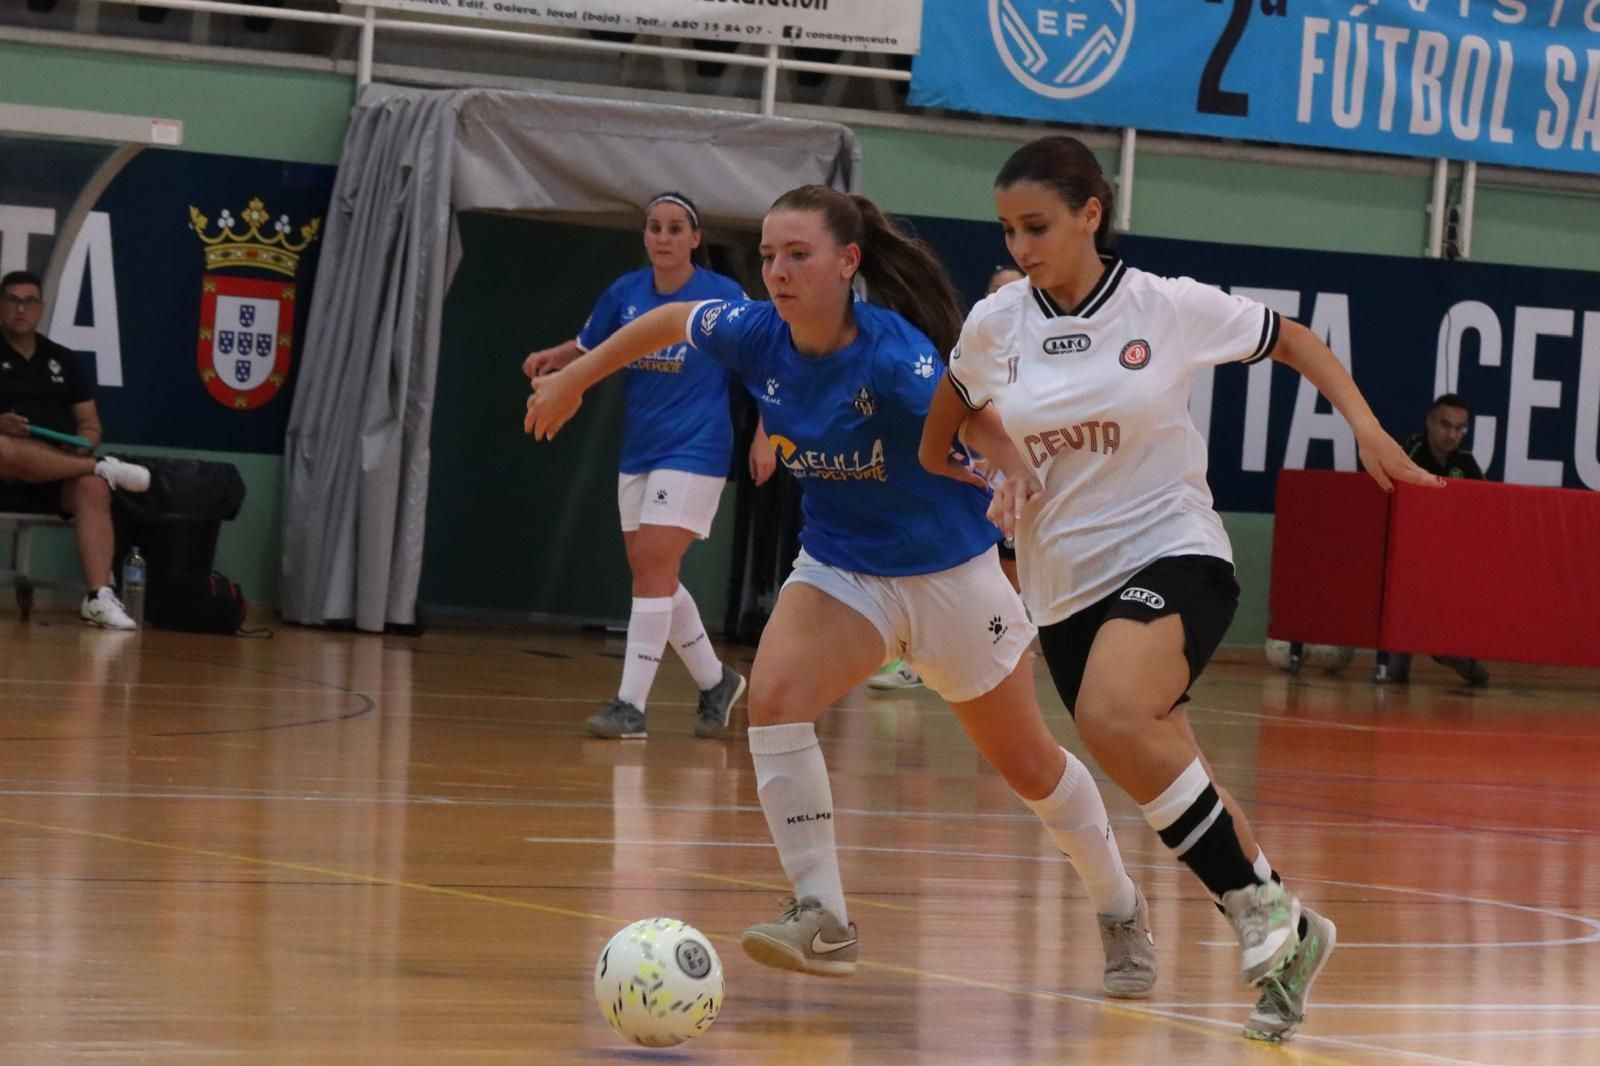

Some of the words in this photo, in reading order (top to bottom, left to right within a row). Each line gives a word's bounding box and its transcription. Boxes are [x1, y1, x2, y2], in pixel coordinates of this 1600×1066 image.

[547, 8, 577, 19] local
[582, 11, 621, 25] (bajo)
[671, 20, 699, 31] 680
[704, 22, 720, 32] 15
[724, 23, 741, 34] 84
[746, 25, 763, 35] 07
[1297, 4, 1515, 144] FÚTBOL
[1023, 421, 1121, 469] CEUTA
